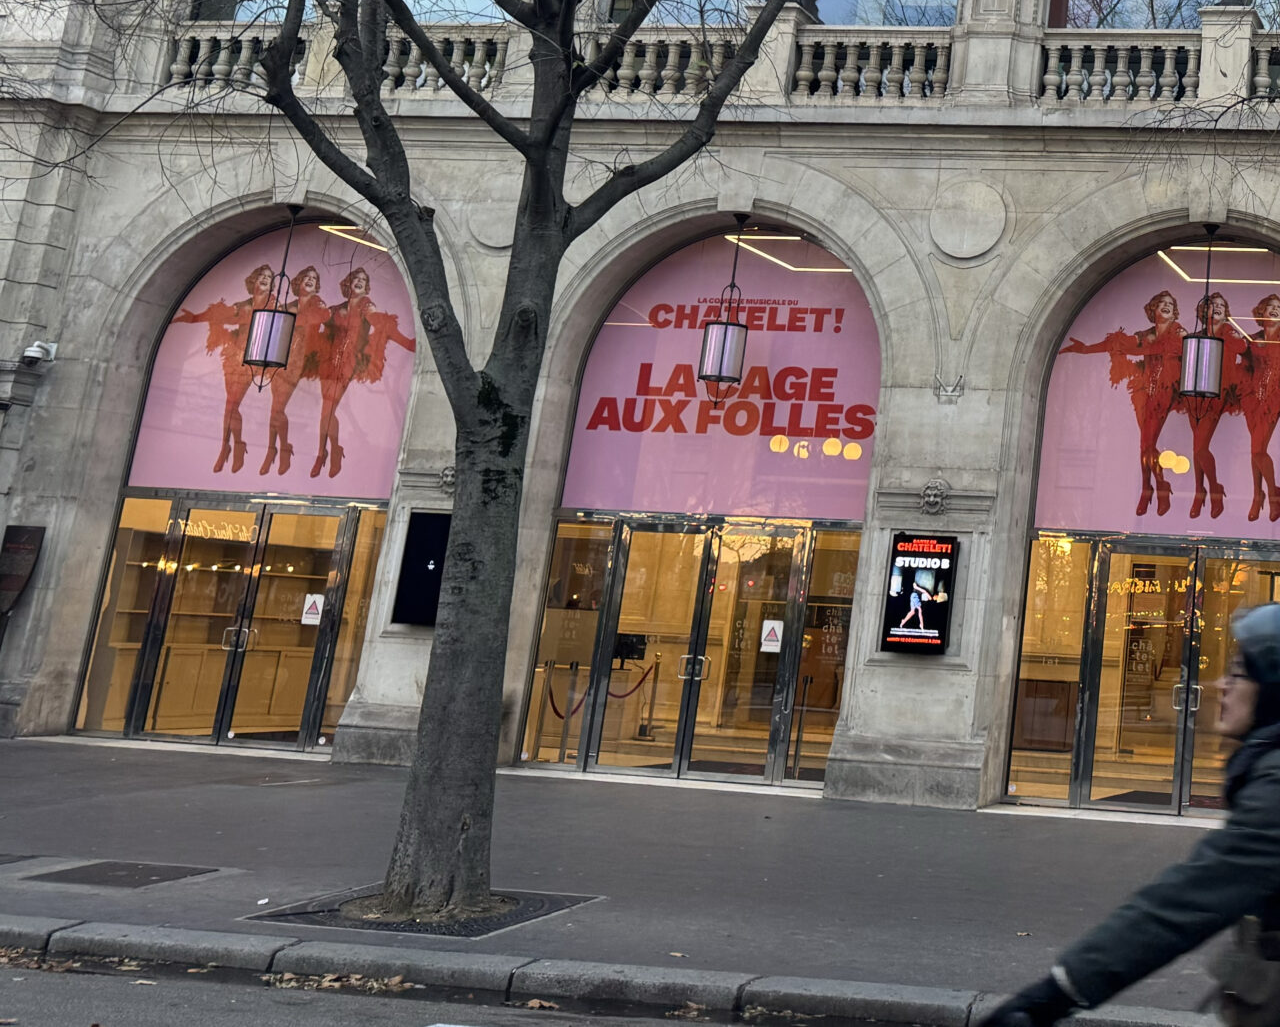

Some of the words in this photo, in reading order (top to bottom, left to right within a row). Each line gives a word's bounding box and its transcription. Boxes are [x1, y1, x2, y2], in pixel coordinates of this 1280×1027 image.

[746, 298, 787, 306] MUSICALE
[635, 362, 697, 399] LA
[586, 396, 694, 434] AUX
[695, 400, 878, 441] FOLLES
[895, 556, 940, 569] STUDIO
[941, 558, 950, 570] B
[1131, 661, 1150, 672] let
